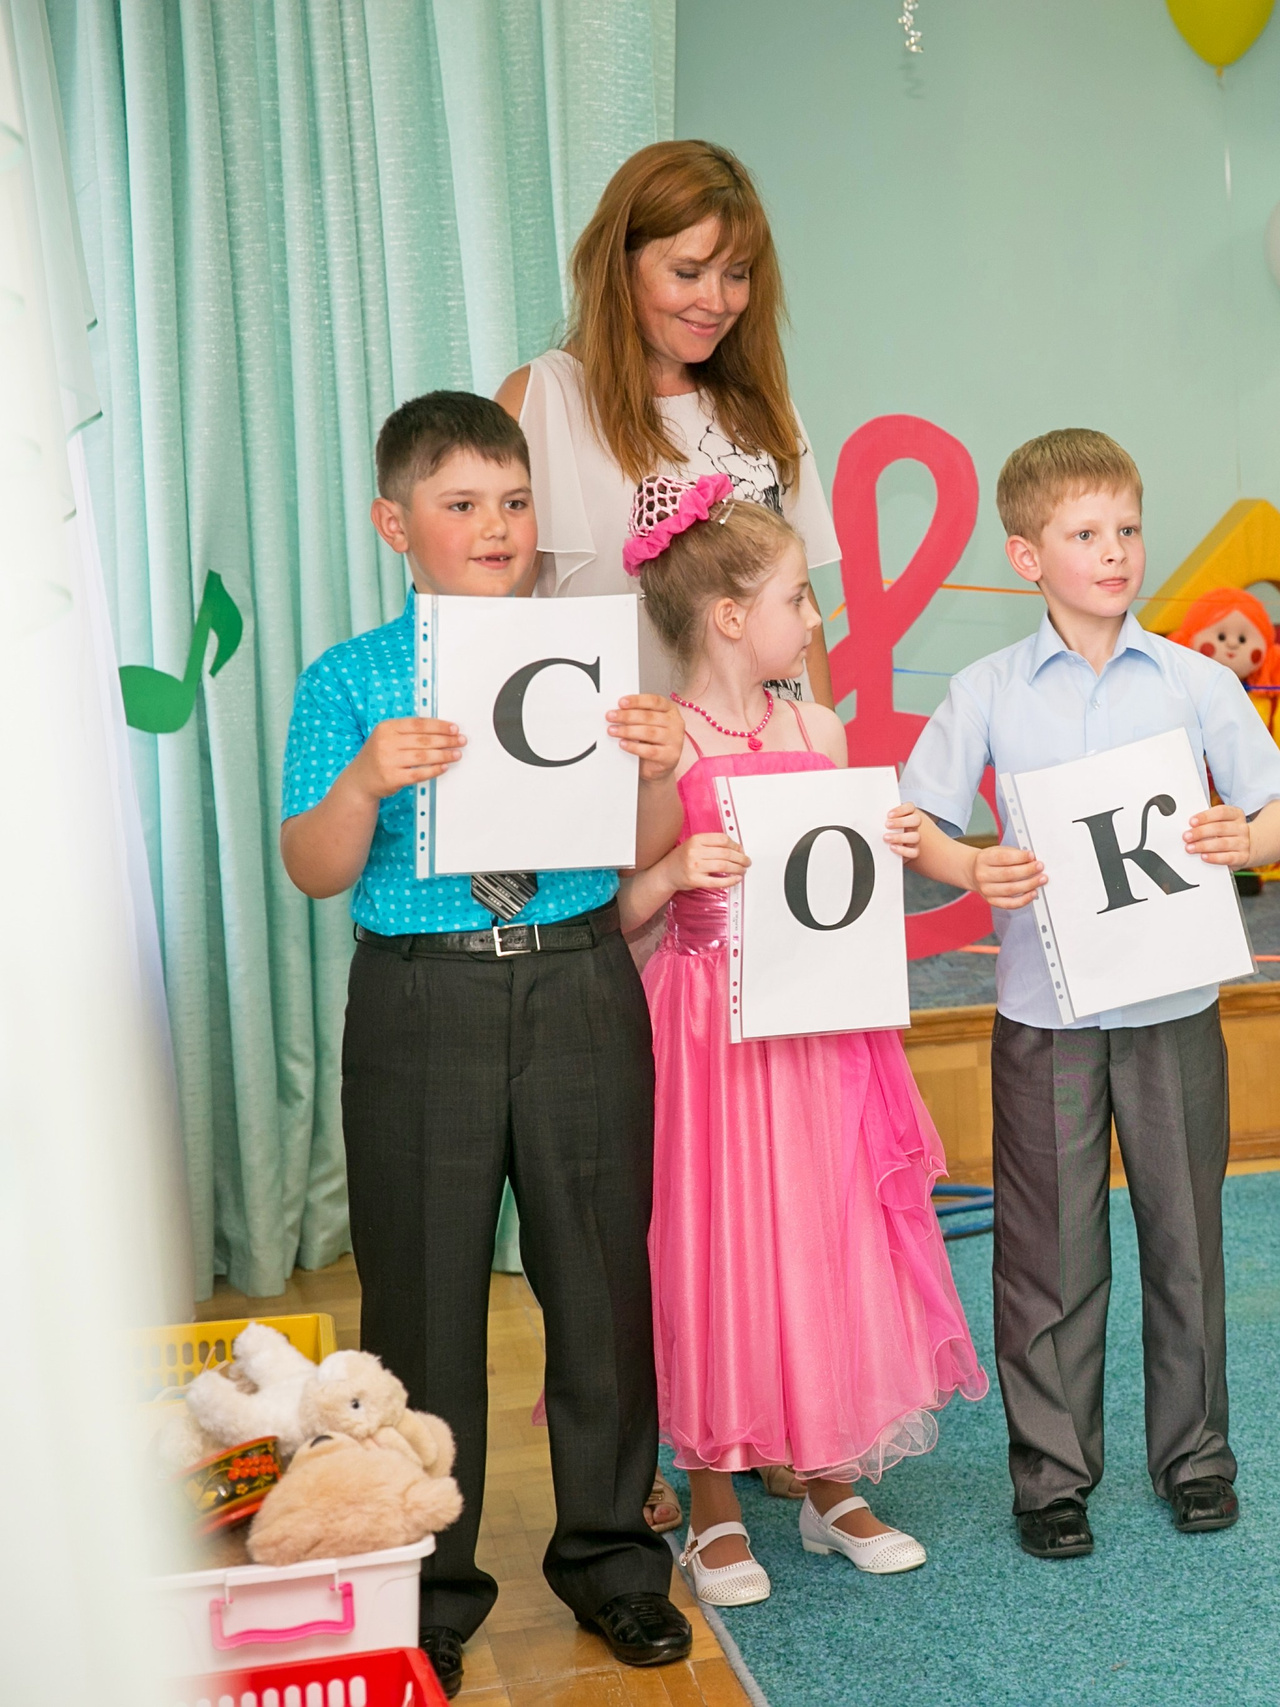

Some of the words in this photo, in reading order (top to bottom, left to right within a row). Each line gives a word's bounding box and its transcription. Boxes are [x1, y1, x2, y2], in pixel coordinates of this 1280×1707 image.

[493, 656, 600, 768] С
[784, 825, 876, 931] О
[1072, 793, 1200, 916] К
